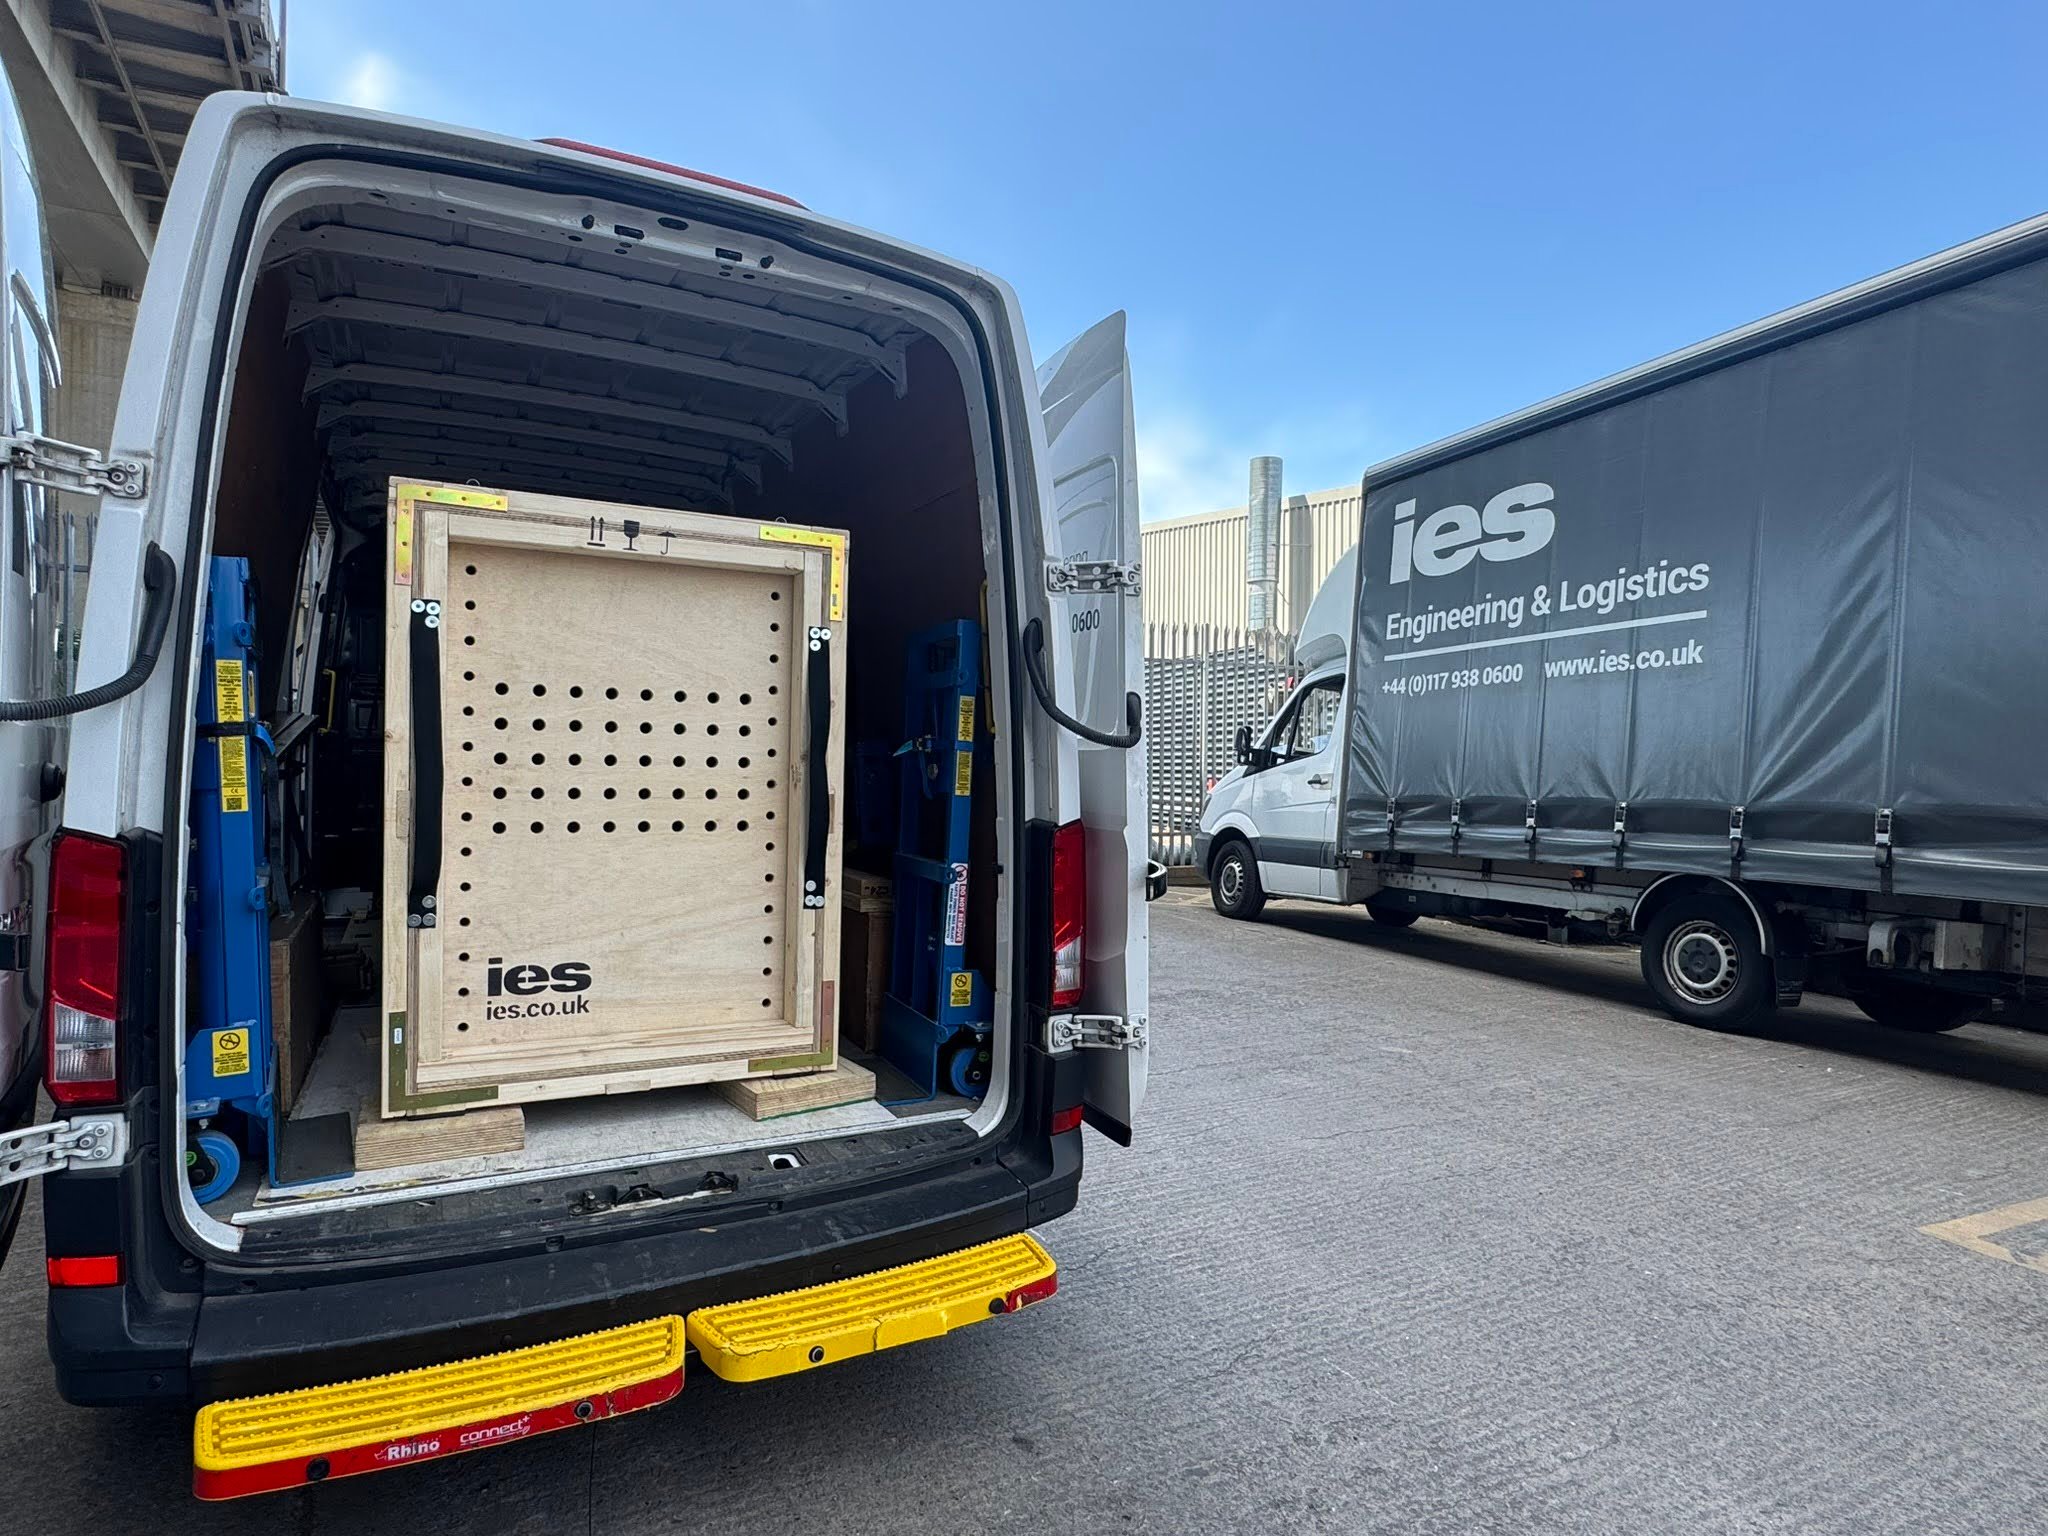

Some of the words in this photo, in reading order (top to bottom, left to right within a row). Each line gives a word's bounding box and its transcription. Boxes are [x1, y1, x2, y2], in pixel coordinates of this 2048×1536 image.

[1389, 481, 1556, 585] ies
[1386, 592, 1524, 644] Engineering
[1530, 584, 1551, 617] &
[1559, 559, 1710, 615] Logistics
[1071, 608, 1100, 633] 0600
[1545, 639, 1704, 679] www.ies.co.uk
[1382, 679, 1406, 695] +44
[1451, 667, 1479, 688] 938
[1482, 663, 1523, 684] 0600
[487, 957, 592, 997] ies
[486, 994, 590, 1021] ies.co.uk
[387, 1440, 440, 1461] Rhino
